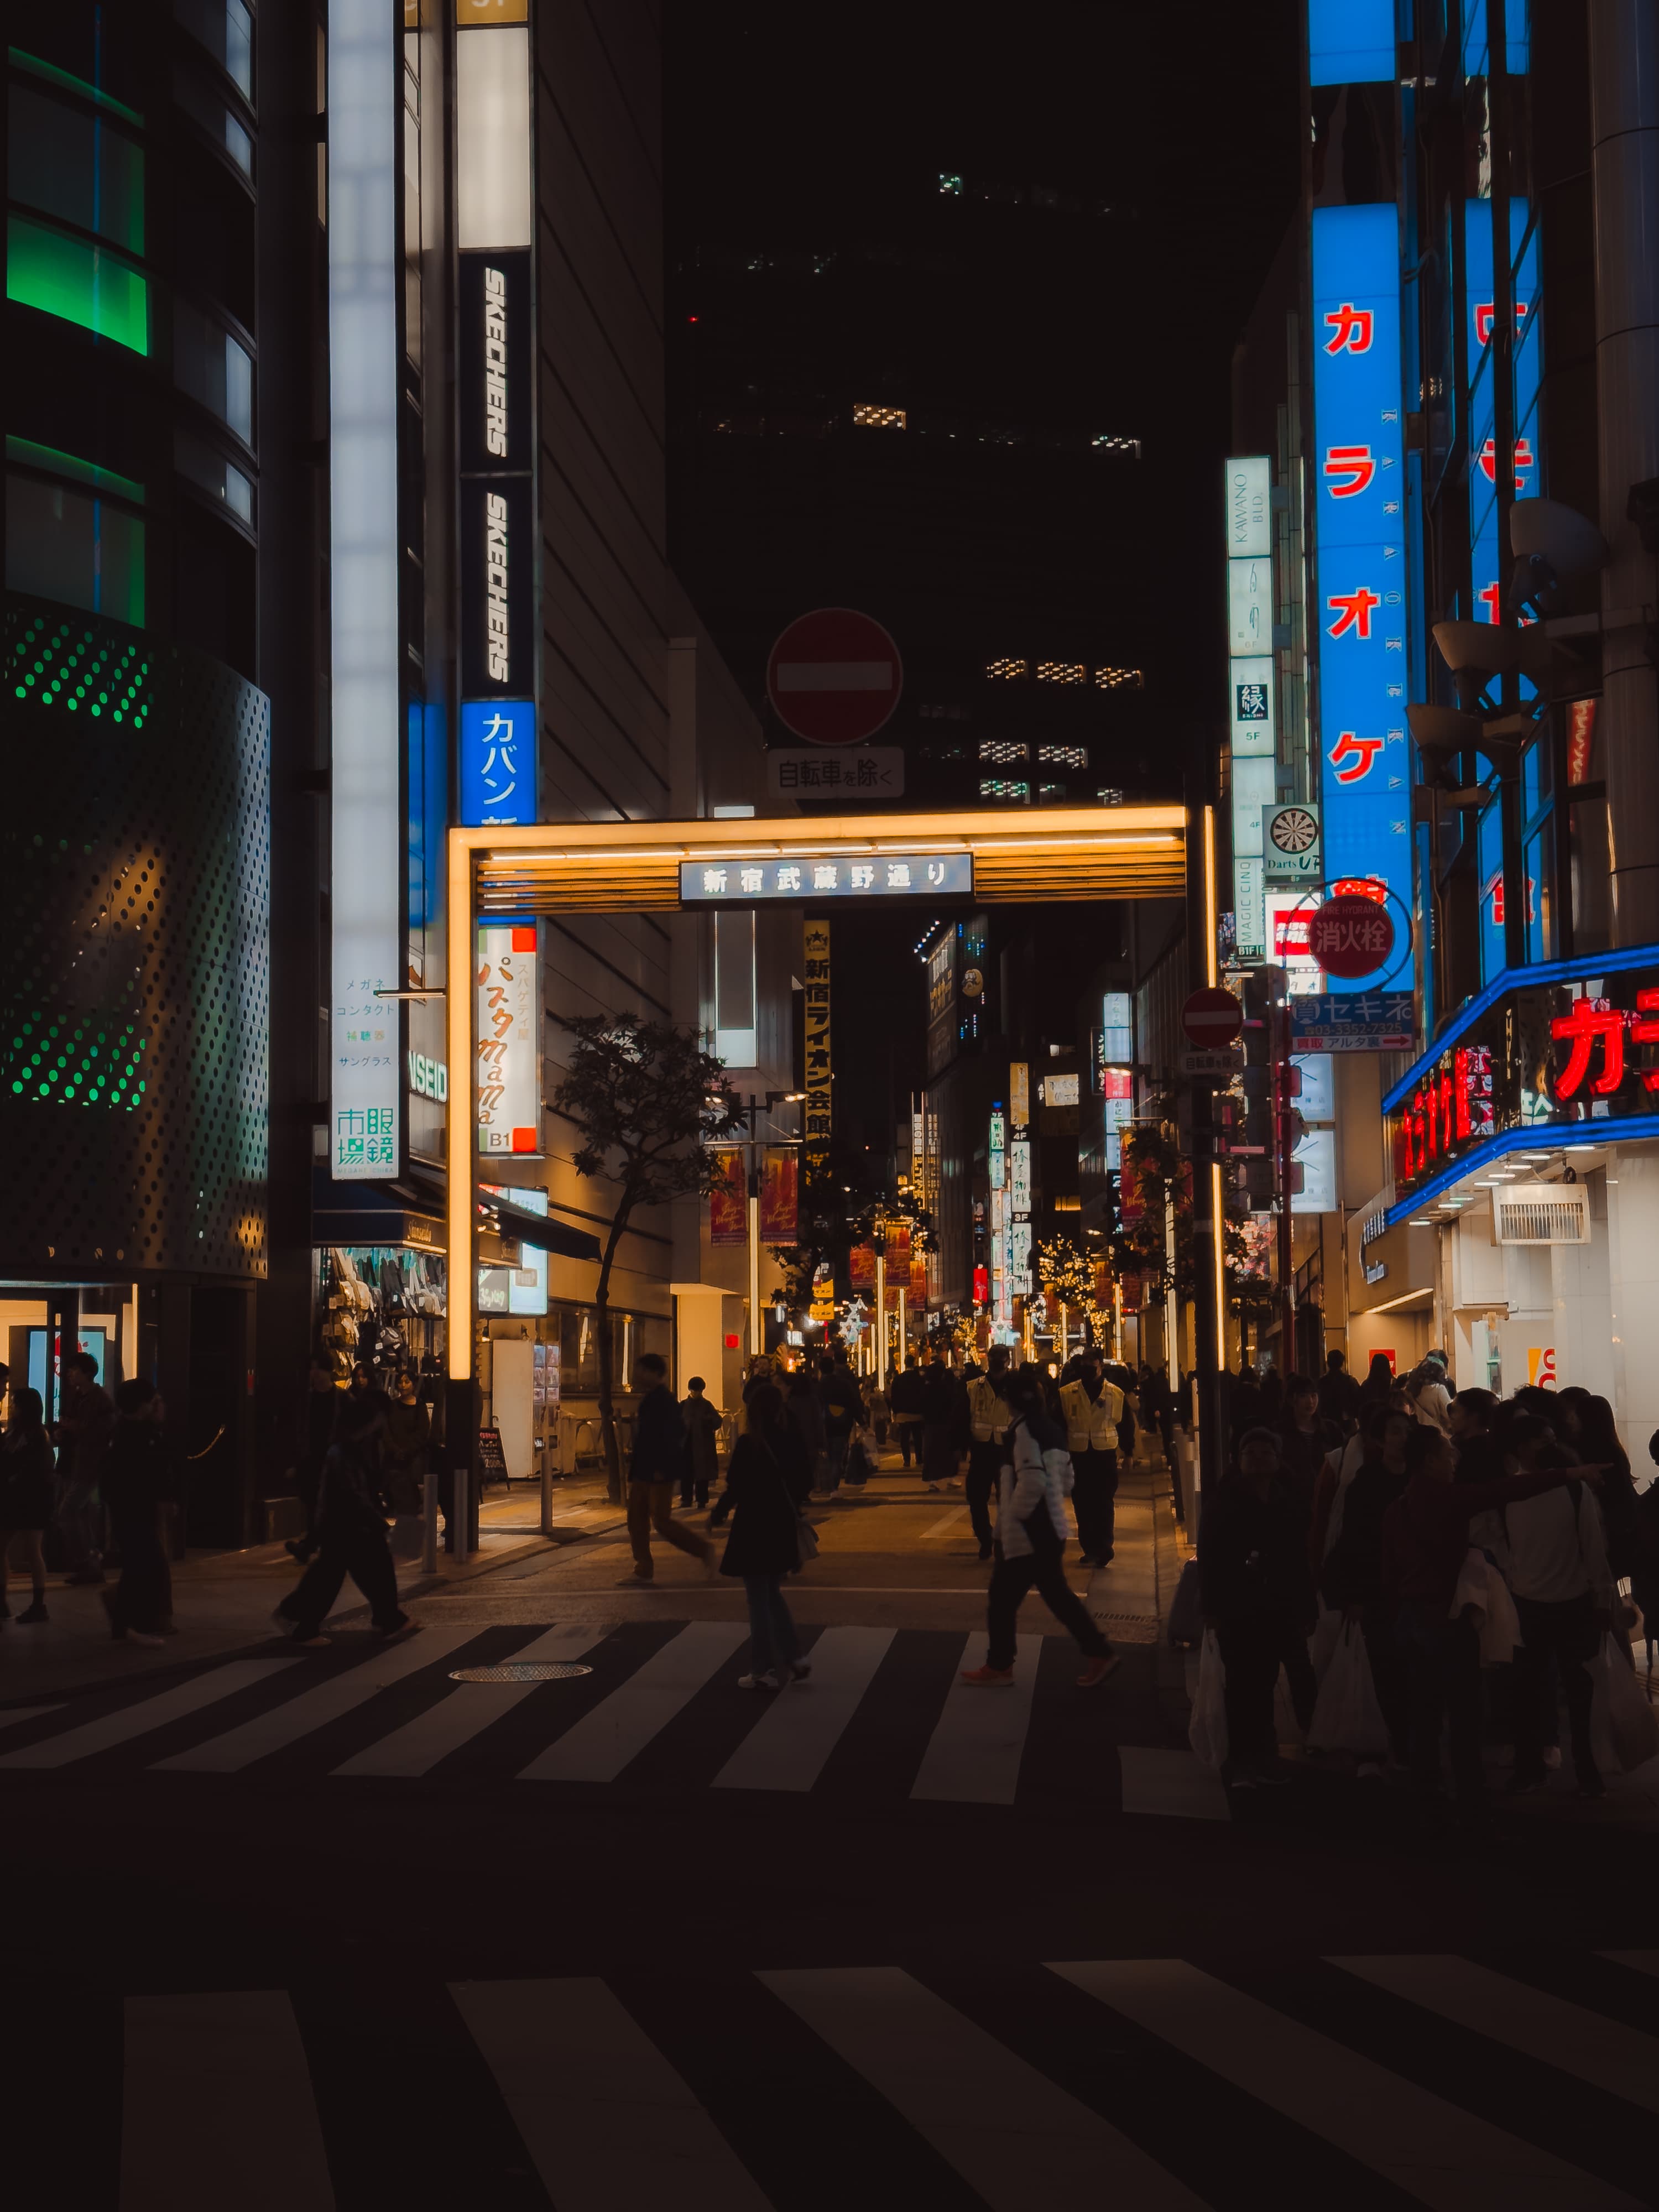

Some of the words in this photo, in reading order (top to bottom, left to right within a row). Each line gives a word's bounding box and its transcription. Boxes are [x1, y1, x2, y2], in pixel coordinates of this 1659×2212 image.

[484, 267, 508, 457] SKECHERS
[1234, 474, 1248, 543] KAWANO
[486, 493, 508, 683] SKECHERS
[1241, 685, 1265, 713] 縁
[1245, 732, 1261, 740] 5F
[481, 713, 518, 824] カバン
[779, 758, 893, 789] 自転車を除く
[1267, 859, 1297, 869] Darts
[703, 862, 946, 894] 新宿武蔵野通り
[1322, 906, 1340, 915] FIRE
[1342, 905, 1379, 915] HYDRANT
[1240, 901, 1251, 943] MAGIC
[1316, 920, 1387, 953] 消火栓
[1238, 946, 1254, 956] B1F
[347, 978, 385, 991] メガネ
[336, 1004, 394, 1016] コンタクト
[1323, 994, 1412, 1024] セキネ
[1315, 1022, 1402, 1035] 03-3352-7325
[805, 958, 831, 1136] 新宿ライオン会館
[1297, 1037, 1323, 1049] 買取
[1328, 1037, 1381, 1048] アルタ裏
[339, 1056, 392, 1067] サングラス
[1186, 1056, 1240, 1070] 自転車を除く
[490, 1132, 510, 1146] B1
[1014, 1213, 1029, 1222] 3F
